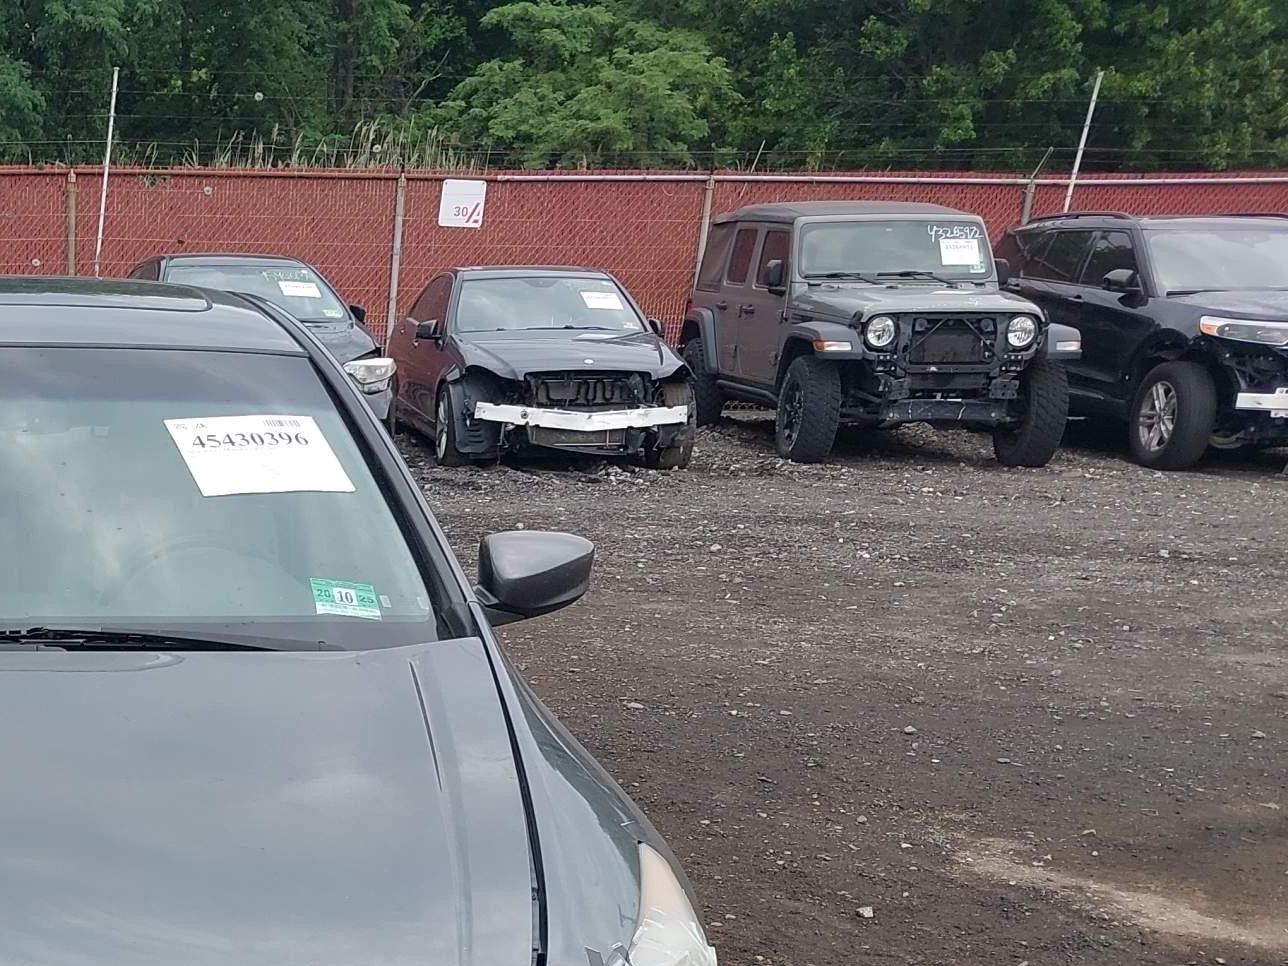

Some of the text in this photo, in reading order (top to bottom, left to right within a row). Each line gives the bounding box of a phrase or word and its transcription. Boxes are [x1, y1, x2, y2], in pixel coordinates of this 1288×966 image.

[192, 431, 310, 449] 45430396
[316, 588, 332, 598] 20
[336, 590, 354, 604] 10
